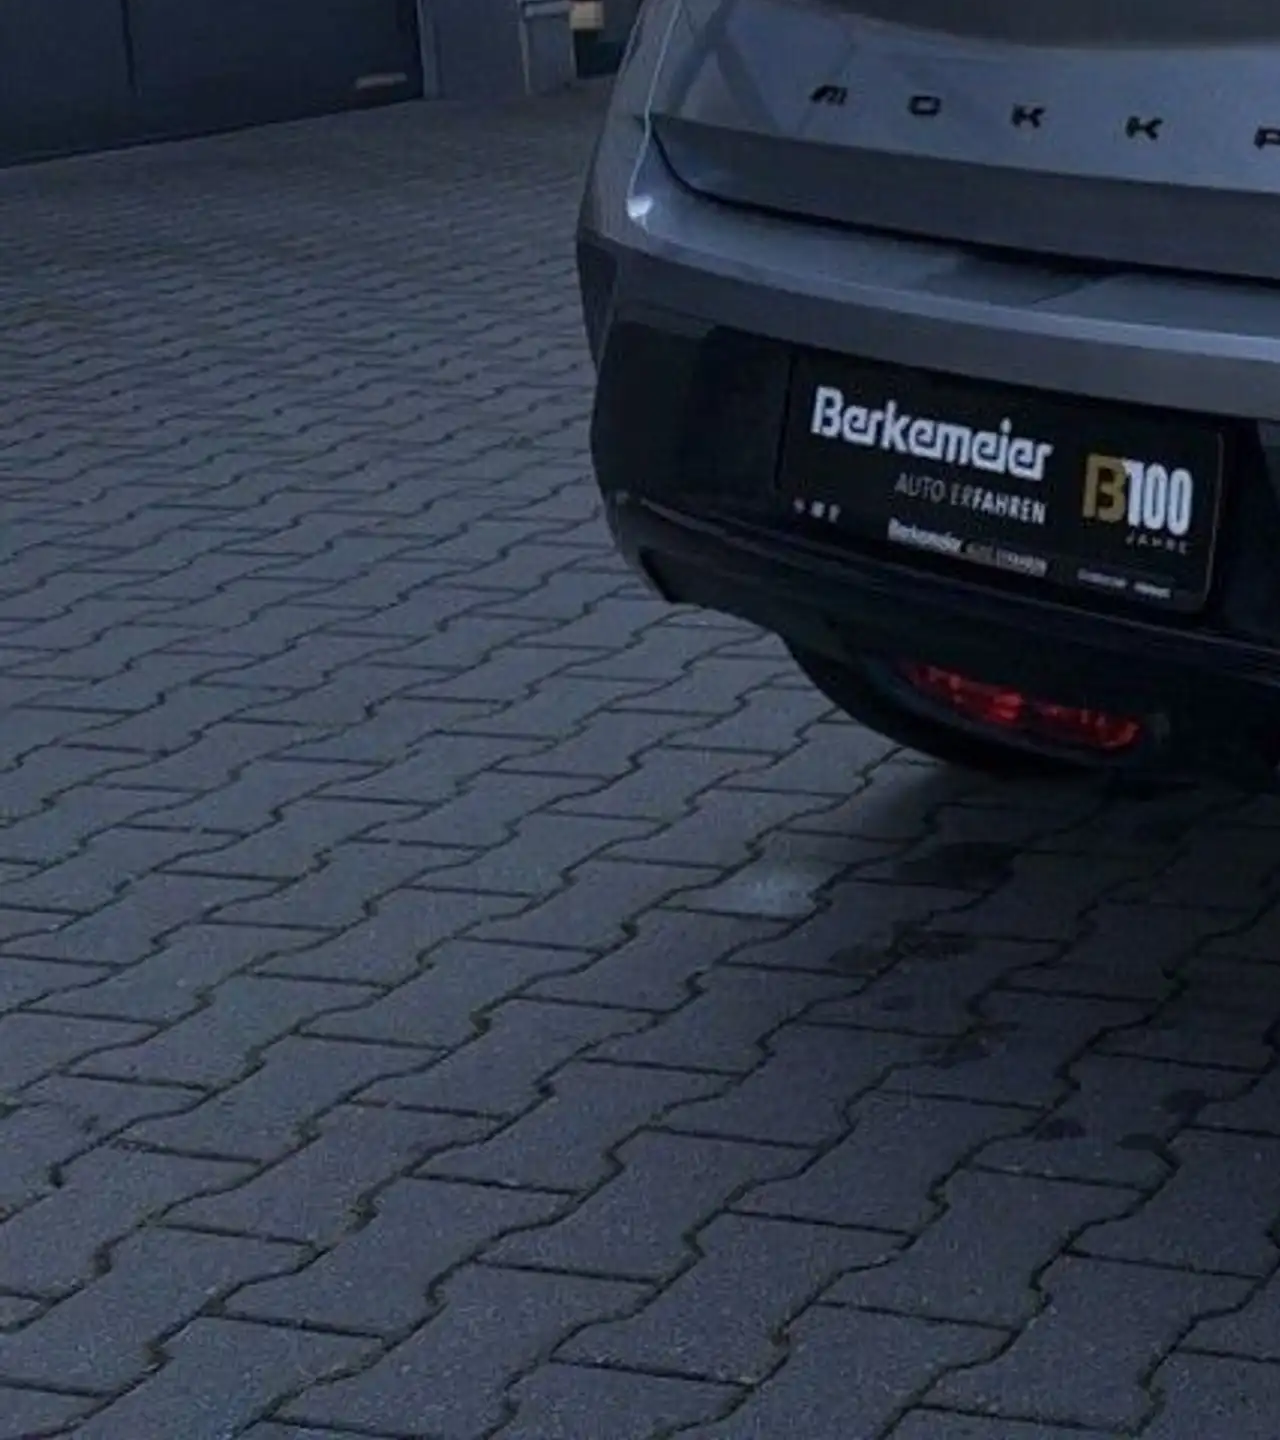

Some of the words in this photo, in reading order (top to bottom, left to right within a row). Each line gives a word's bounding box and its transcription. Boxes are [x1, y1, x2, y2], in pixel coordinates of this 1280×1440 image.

[811, 386, 1054, 482] Berkemeier
[894, 471, 946, 506] AUTO
[950, 481, 1047, 525] ERFAHREN
